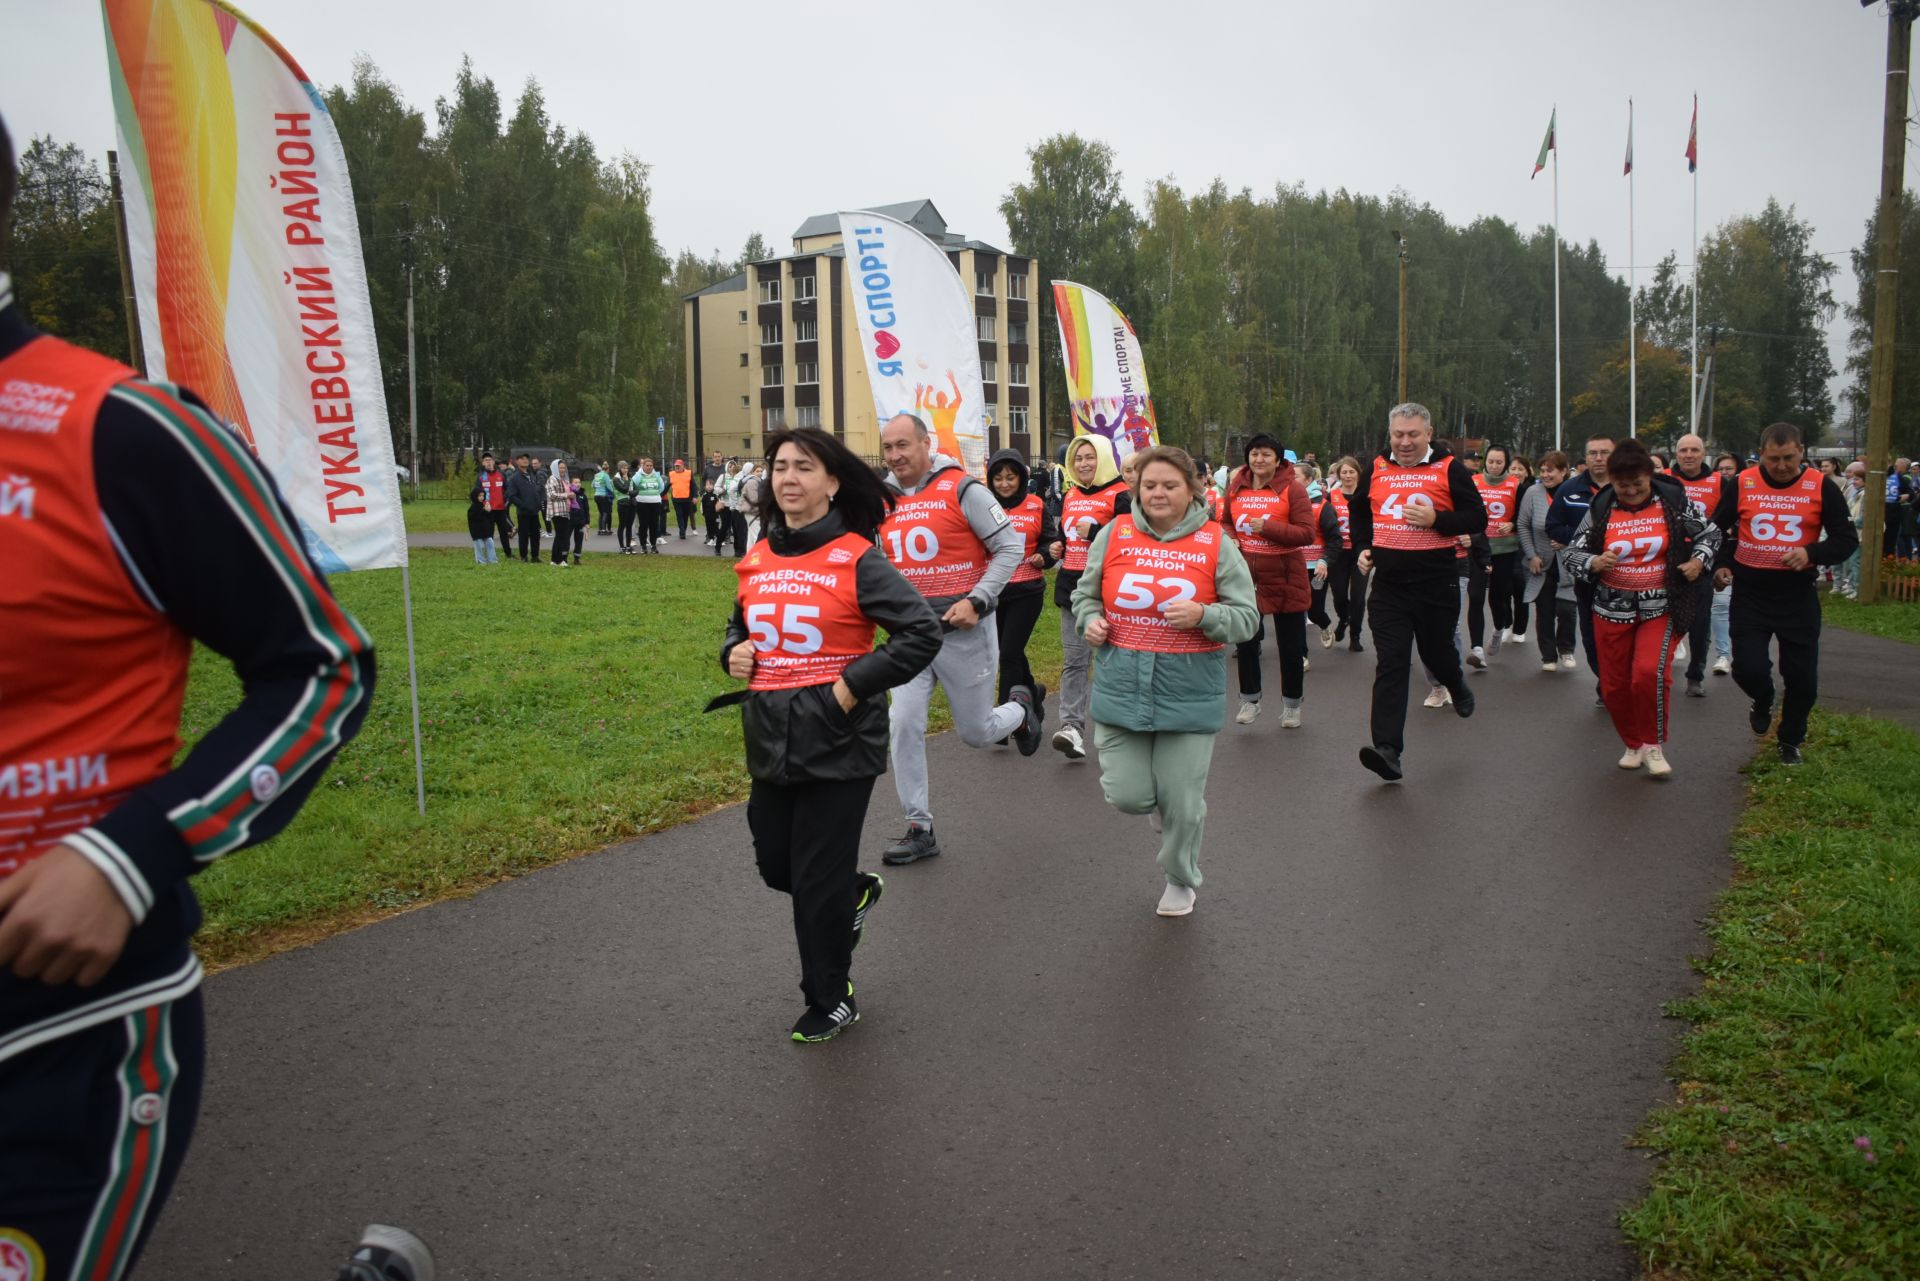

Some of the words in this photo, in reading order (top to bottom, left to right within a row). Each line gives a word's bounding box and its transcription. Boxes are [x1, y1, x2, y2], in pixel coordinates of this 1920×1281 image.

[270, 112, 324, 246] РАЙОН
[855, 227, 896, 328] СПОРТ!
[1113, 326, 1130, 374] СПОРТА!
[878, 360, 904, 377] Я
[284, 267, 367, 523] ТУКАЕВСКИЙ
[1380, 474, 1437, 483] ТУКАЕВСКИЙ
[1390, 480, 1422, 488] РАЙОН
[1747, 494, 1810, 504] ТУКАЕВСКИЙ
[1759, 502, 1795, 510] РАЙОН
[895, 511, 929, 523] РАЙОН
[1618, 526, 1653, 536] РАЙОН
[1750, 513, 1803, 542] 63
[887, 526, 939, 562] 10
[1608, 536, 1664, 564] 27
[1120, 547, 1206, 564] ТУКАЕВСКИЙ
[936, 562, 973, 574] ЖИЗНИ
[1136, 558, 1184, 571] РАЙОН
[748, 569, 837, 588] ТУКАЕВСКИЙ
[758, 580, 811, 595] РАЙОН
[1114, 573, 1197, 612] 52
[747, 603, 823, 655] 55
[1131, 616, 1171, 627] НОРМ
[0, 753, 108, 799] ИЗНИ
